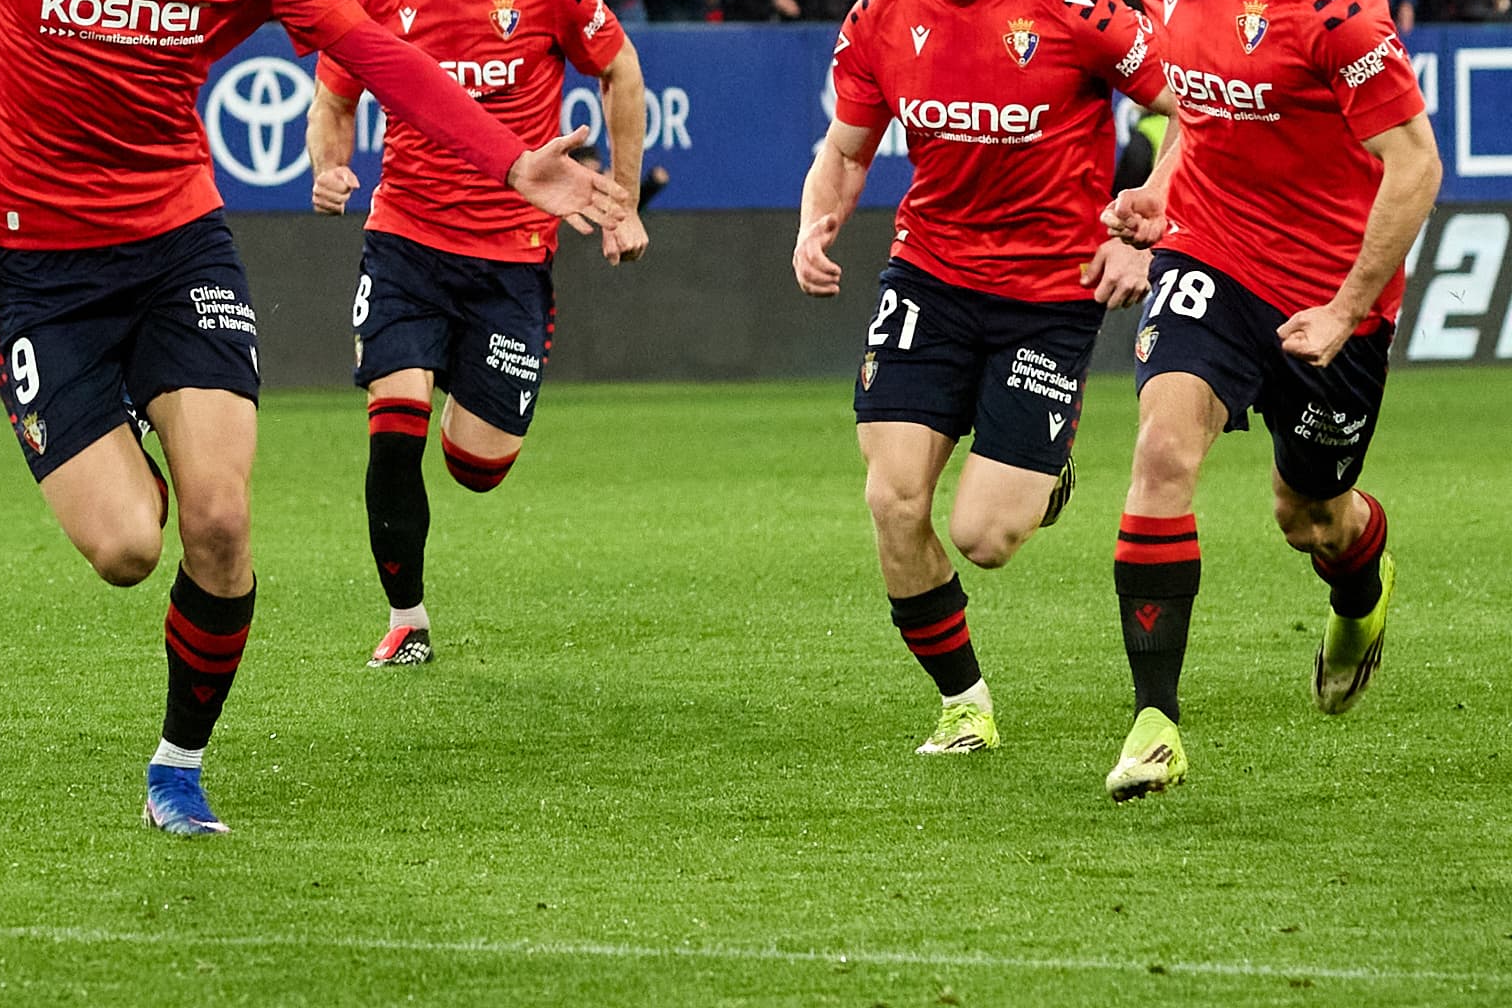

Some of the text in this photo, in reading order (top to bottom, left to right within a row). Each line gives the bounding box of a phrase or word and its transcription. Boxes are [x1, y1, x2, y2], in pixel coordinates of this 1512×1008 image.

[1339, 42, 1389, 77] SALTOKI
[1345, 58, 1386, 88] HOME
[190, 285, 235, 302] Clínica
[1149, 268, 1216, 320] 18
[198, 315, 216, 330] de
[868, 288, 921, 350] 21
[489, 333, 526, 353] Clínica
[11, 337, 40, 405] 9
[486, 355, 500, 369] de
[1016, 347, 1057, 371] Clínica
[1007, 374, 1072, 404] de Navarra
[1011, 360, 1078, 392] Universidad
[1294, 424, 1312, 440] de
